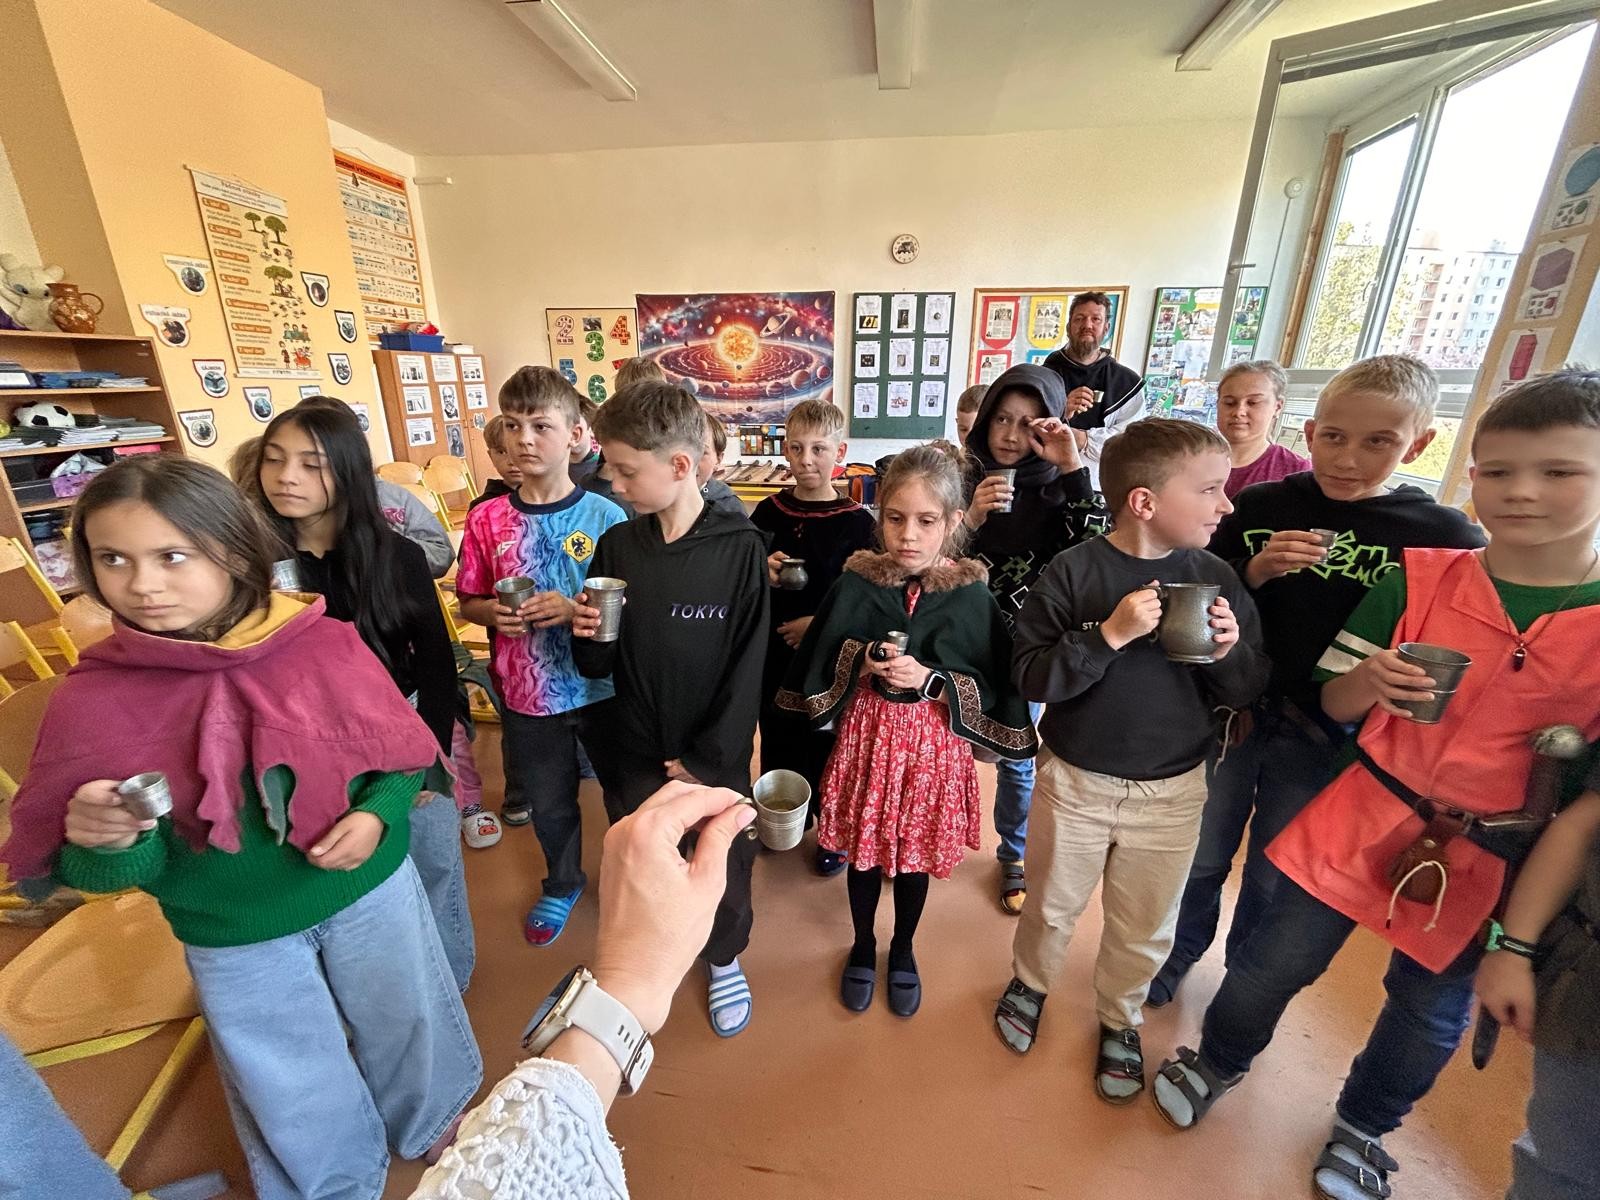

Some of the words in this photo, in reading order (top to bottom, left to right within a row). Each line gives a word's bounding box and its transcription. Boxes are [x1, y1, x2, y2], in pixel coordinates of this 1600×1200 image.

[555, 314, 575, 345] 2
[610, 315, 631, 346] 4
[585, 331, 605, 362] 3
[588, 374, 607, 403] 6
[671, 602, 728, 619] TOKYO
